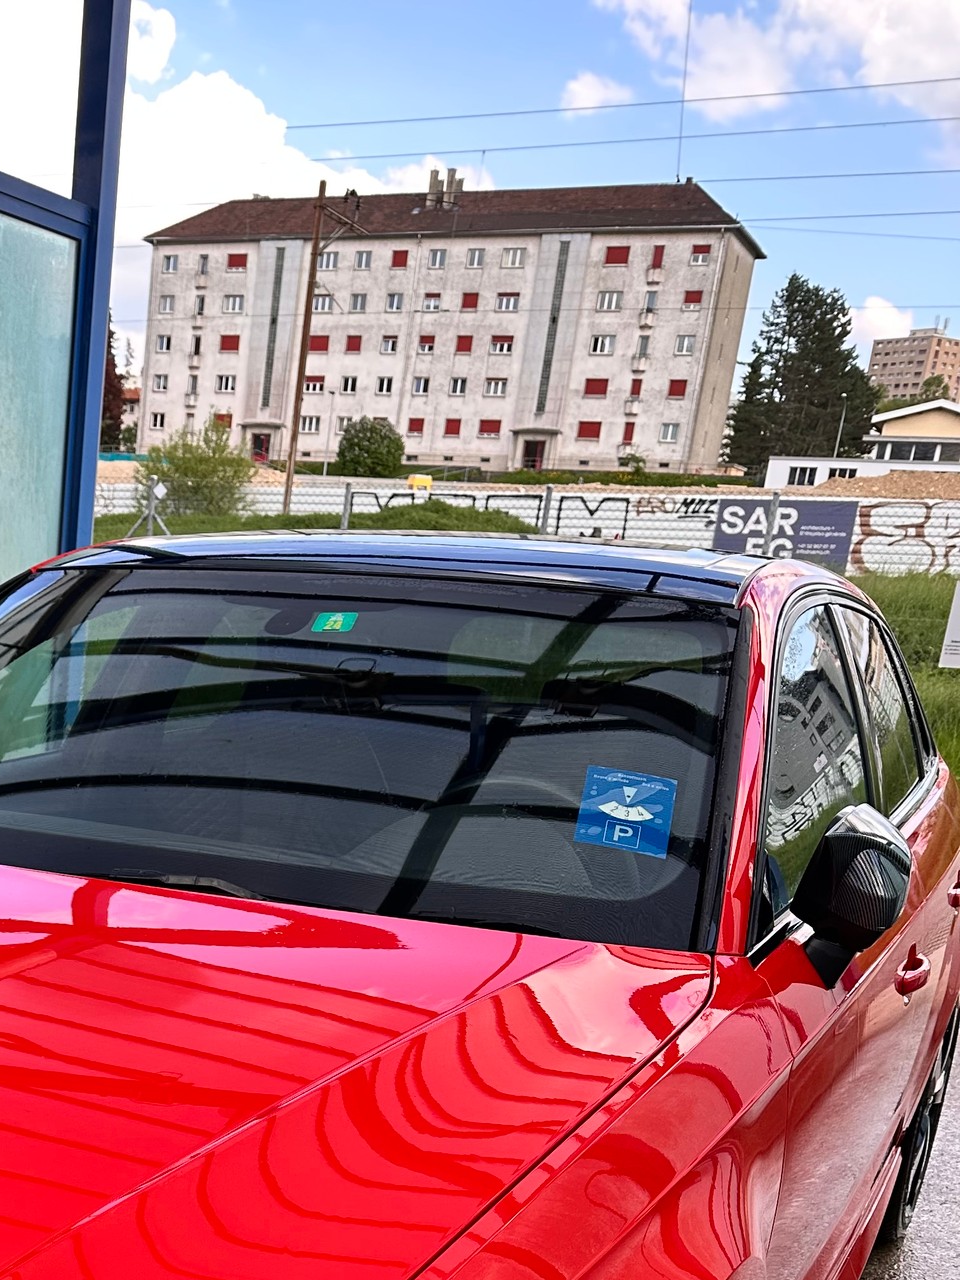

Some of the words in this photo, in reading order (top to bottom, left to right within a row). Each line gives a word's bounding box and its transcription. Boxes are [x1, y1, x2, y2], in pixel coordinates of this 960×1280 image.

[720, 505, 799, 536] SAR
[624, 809, 630, 818] 3
[613, 824, 634, 842] P
